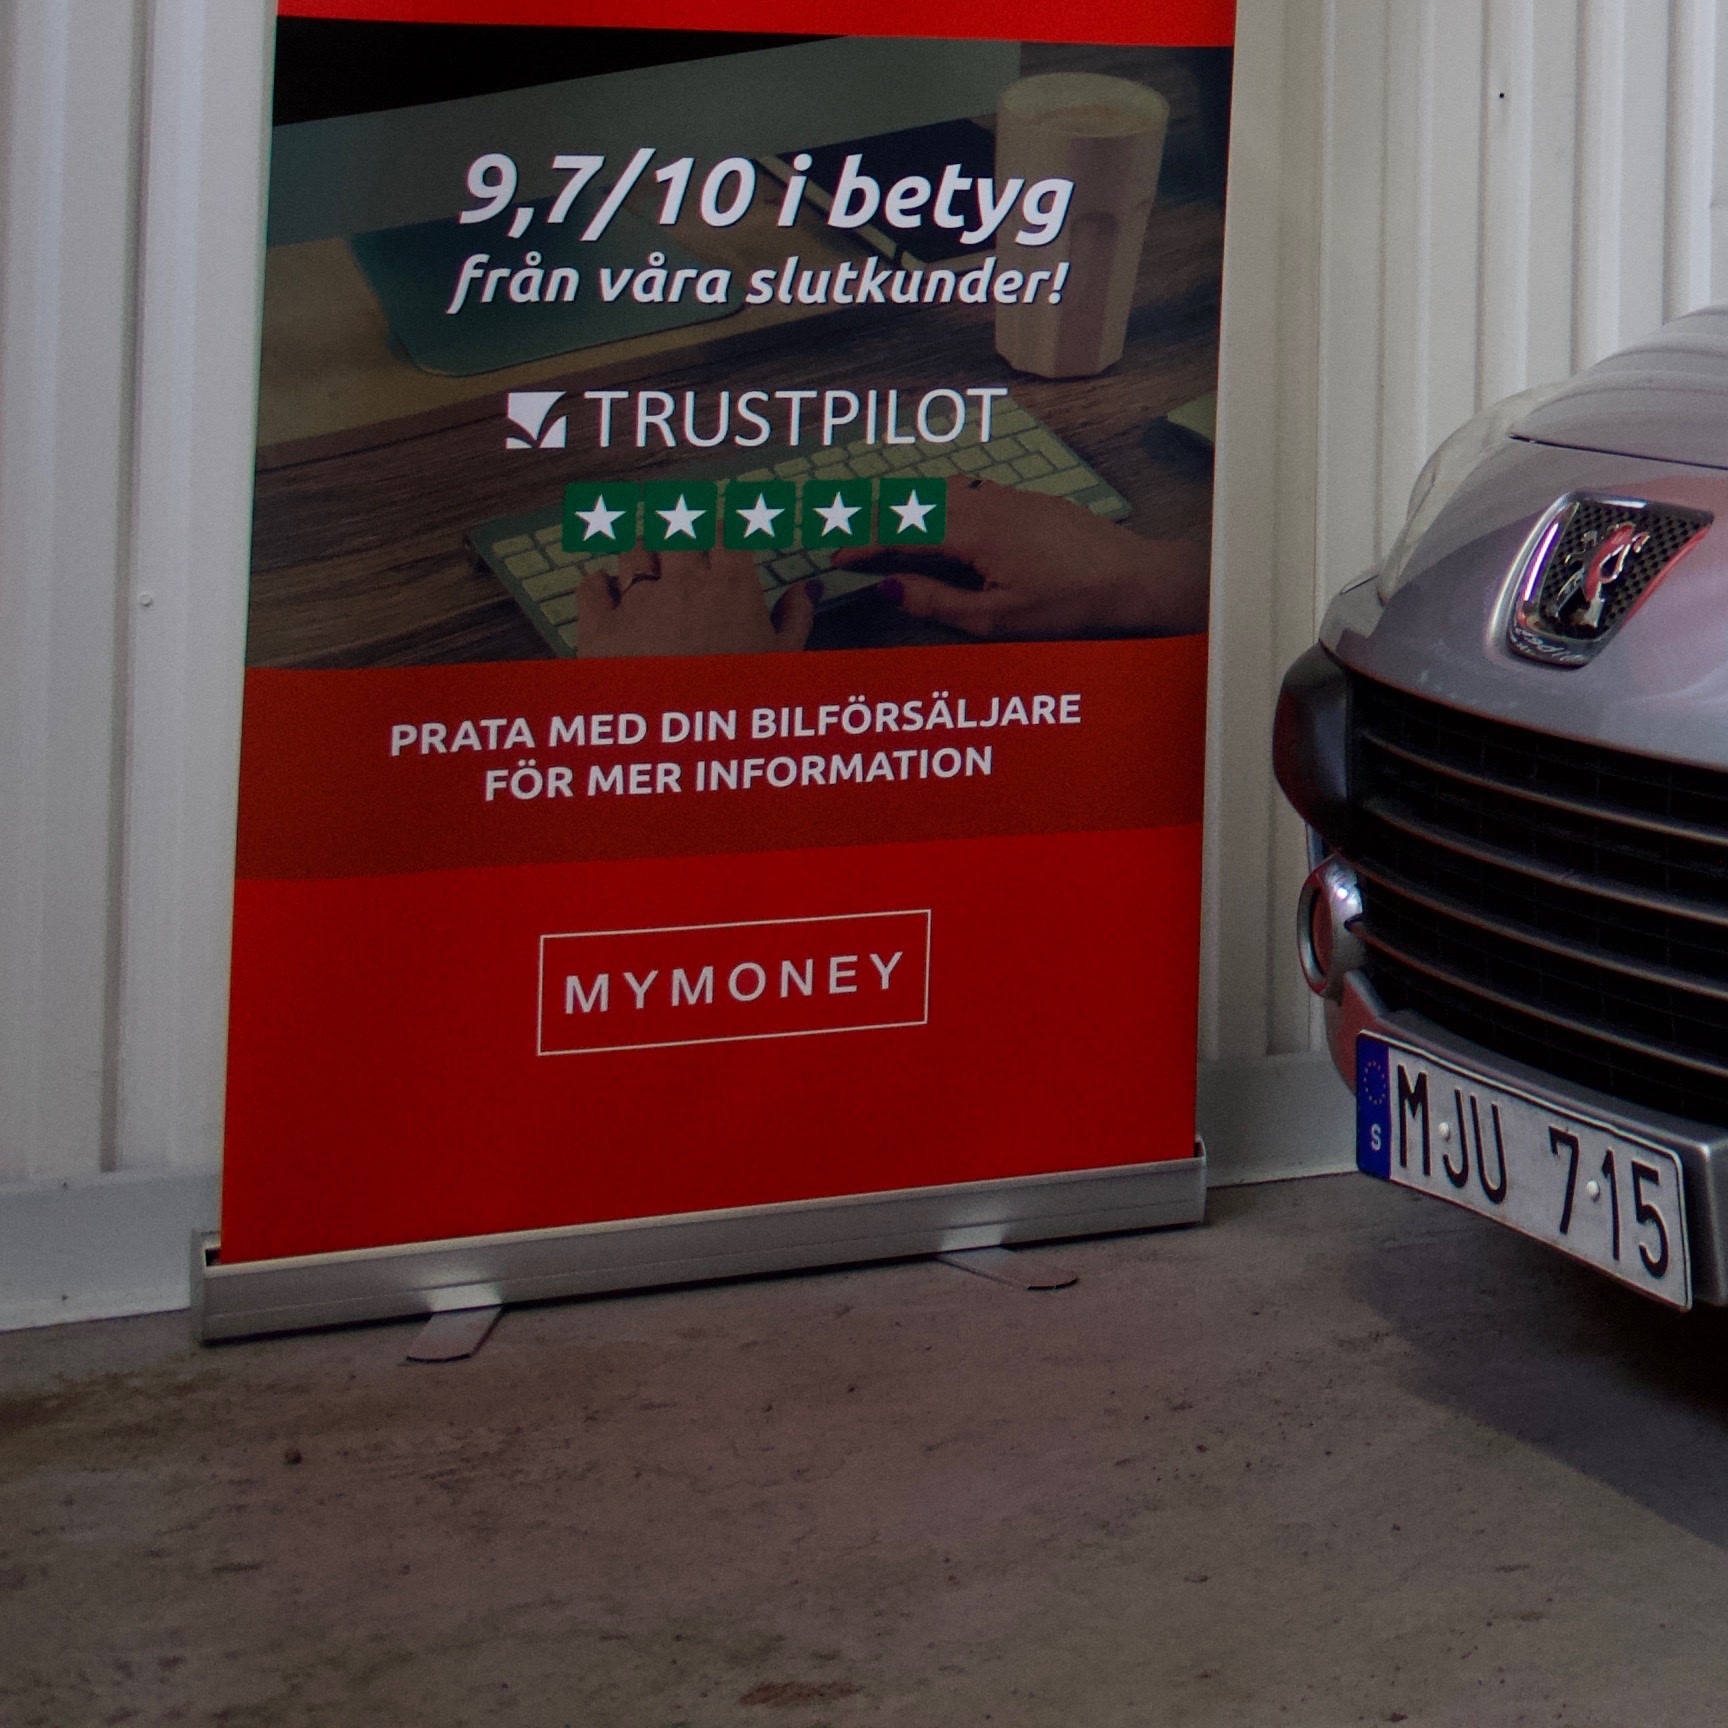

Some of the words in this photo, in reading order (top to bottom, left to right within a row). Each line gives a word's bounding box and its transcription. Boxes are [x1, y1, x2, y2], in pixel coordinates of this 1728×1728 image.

[459, 147, 756, 241] 9,7/10
[777, 153, 812, 227] i
[827, 154, 1074, 246] betyg
[446, 250, 580, 315] från
[600, 251, 731, 304] våra
[745, 255, 1070, 304] slutkunder!
[584, 387, 1008, 448] TRUSTPILOT
[391, 717, 537, 758] PRATA
[548, 713, 647, 747] MED
[661, 709, 737, 744] DIN
[751, 690, 1081, 739] BILFÖRSÄLJARE
[485, 758, 574, 802] FÖR
[587, 762, 682, 797] MER
[696, 745, 992, 792] INFORMATION
[563, 951, 906, 1015] MYMONEY
[1370, 1123, 1382, 1151] S
[1397, 1063, 1508, 1204] MJU
[1549, 1125, 1670, 1278] 715
